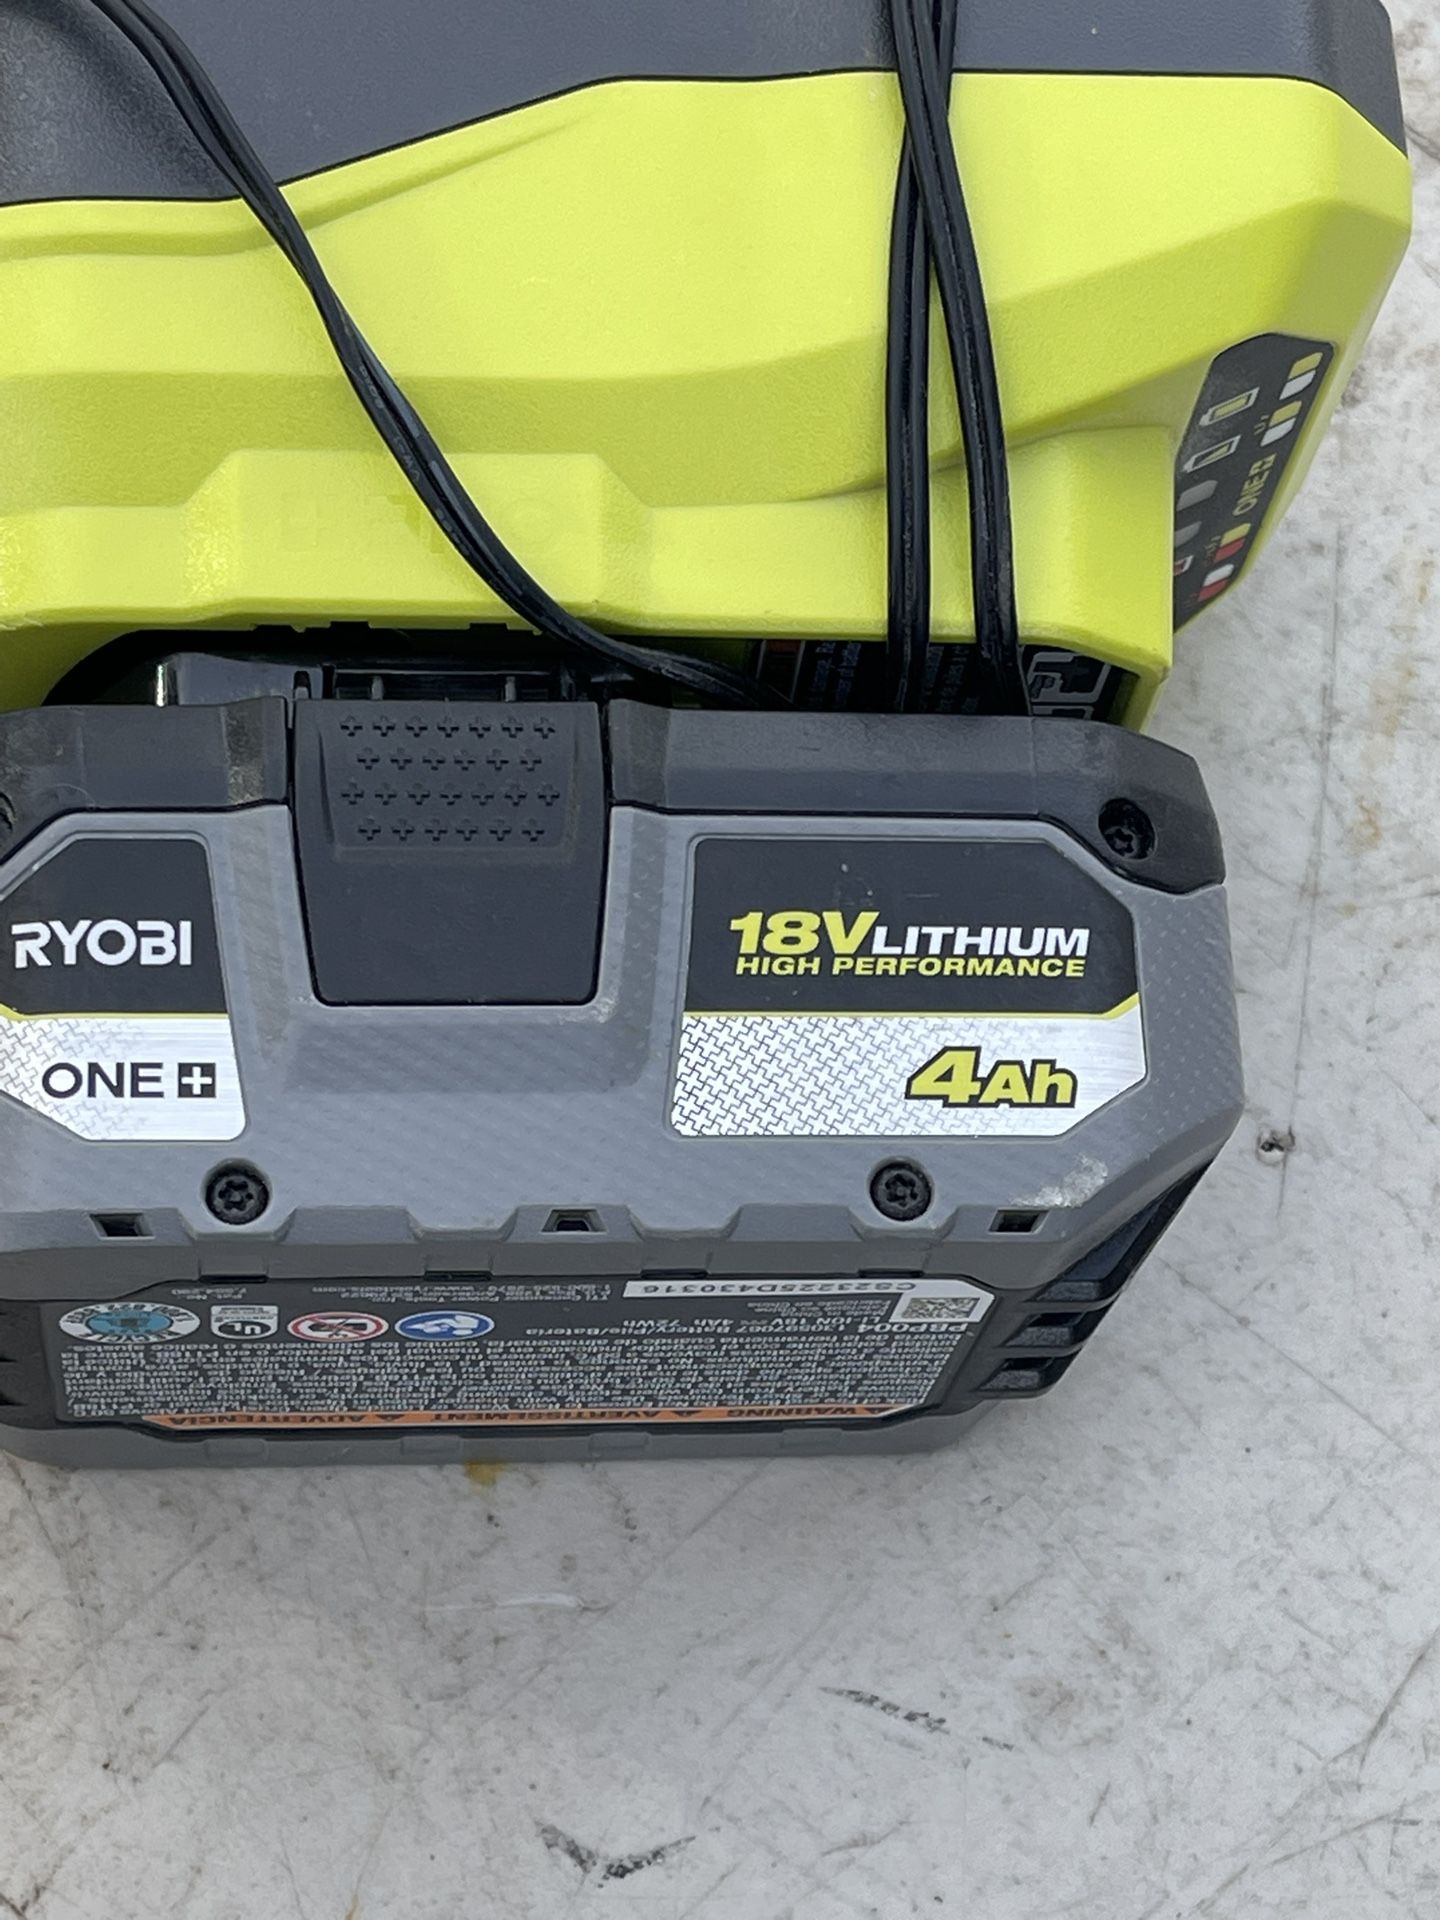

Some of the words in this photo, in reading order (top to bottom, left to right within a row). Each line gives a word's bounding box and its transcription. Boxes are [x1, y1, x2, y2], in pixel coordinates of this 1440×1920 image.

[11, 919, 192, 969] RYOBI
[729, 911, 880, 955] 18V
[871, 926, 1090, 956] LITHIUM
[735, 956, 821, 976] HIGH
[832, 956, 1085, 978] PERFORMANCE
[905, 1046, 1078, 1108] 4Ah
[168, 1415, 365, 1426] ADVERTENCIA
[727, 1407, 856, 1417] WARNING
